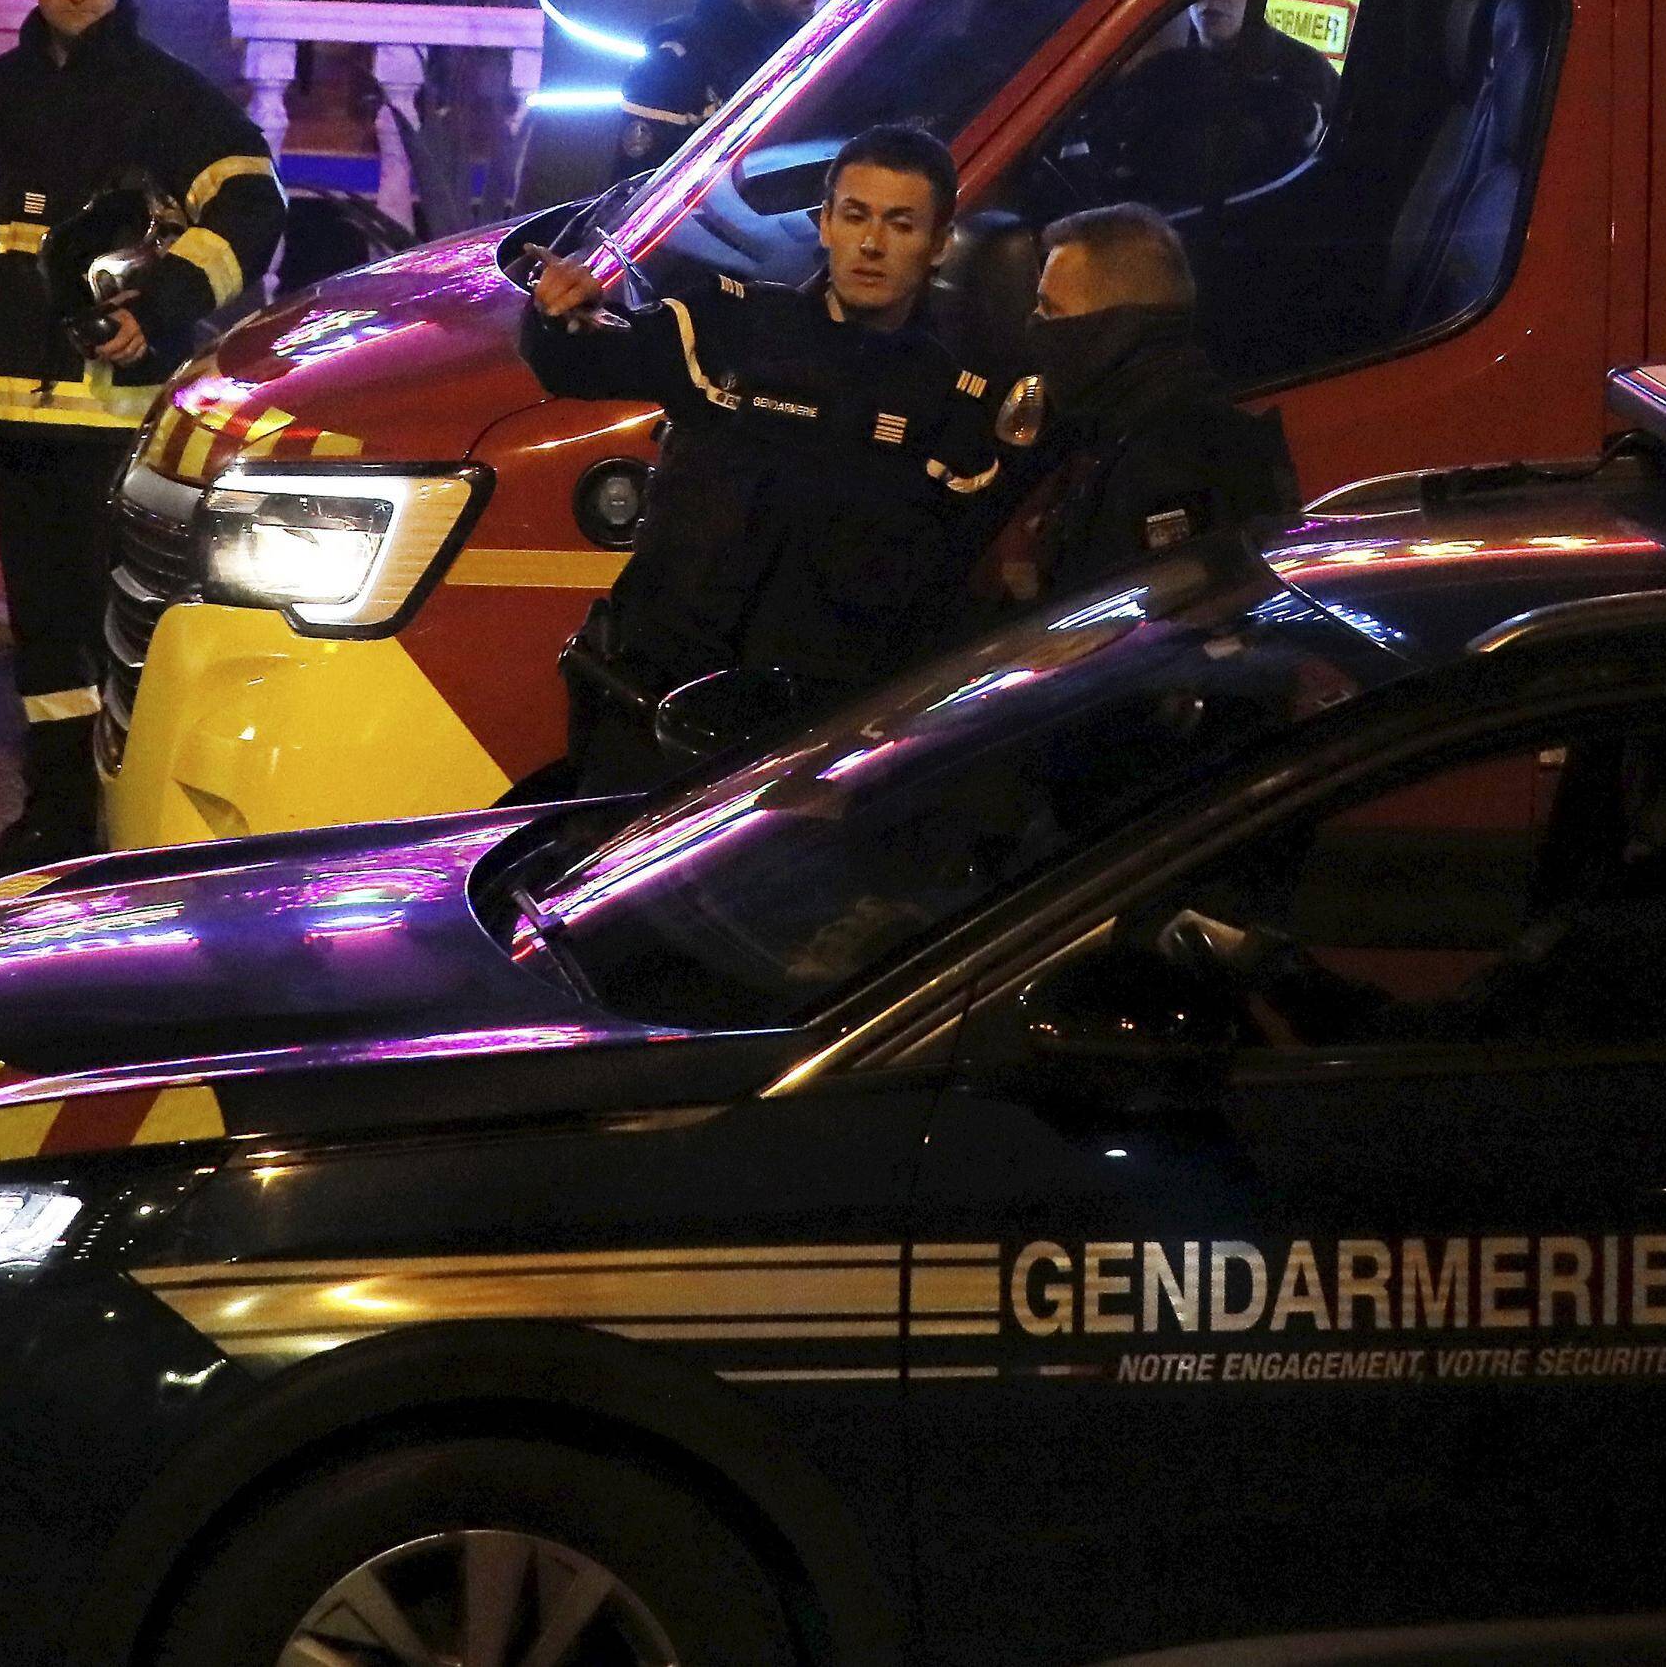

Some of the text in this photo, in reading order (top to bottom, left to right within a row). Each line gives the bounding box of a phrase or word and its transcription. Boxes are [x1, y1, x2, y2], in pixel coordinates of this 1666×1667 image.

[1116, 1350, 1215, 1384] NOTRE
[1222, 1348, 1426, 1385] ENGAGEMENT,
[1437, 1346, 1529, 1379] VOTRE
